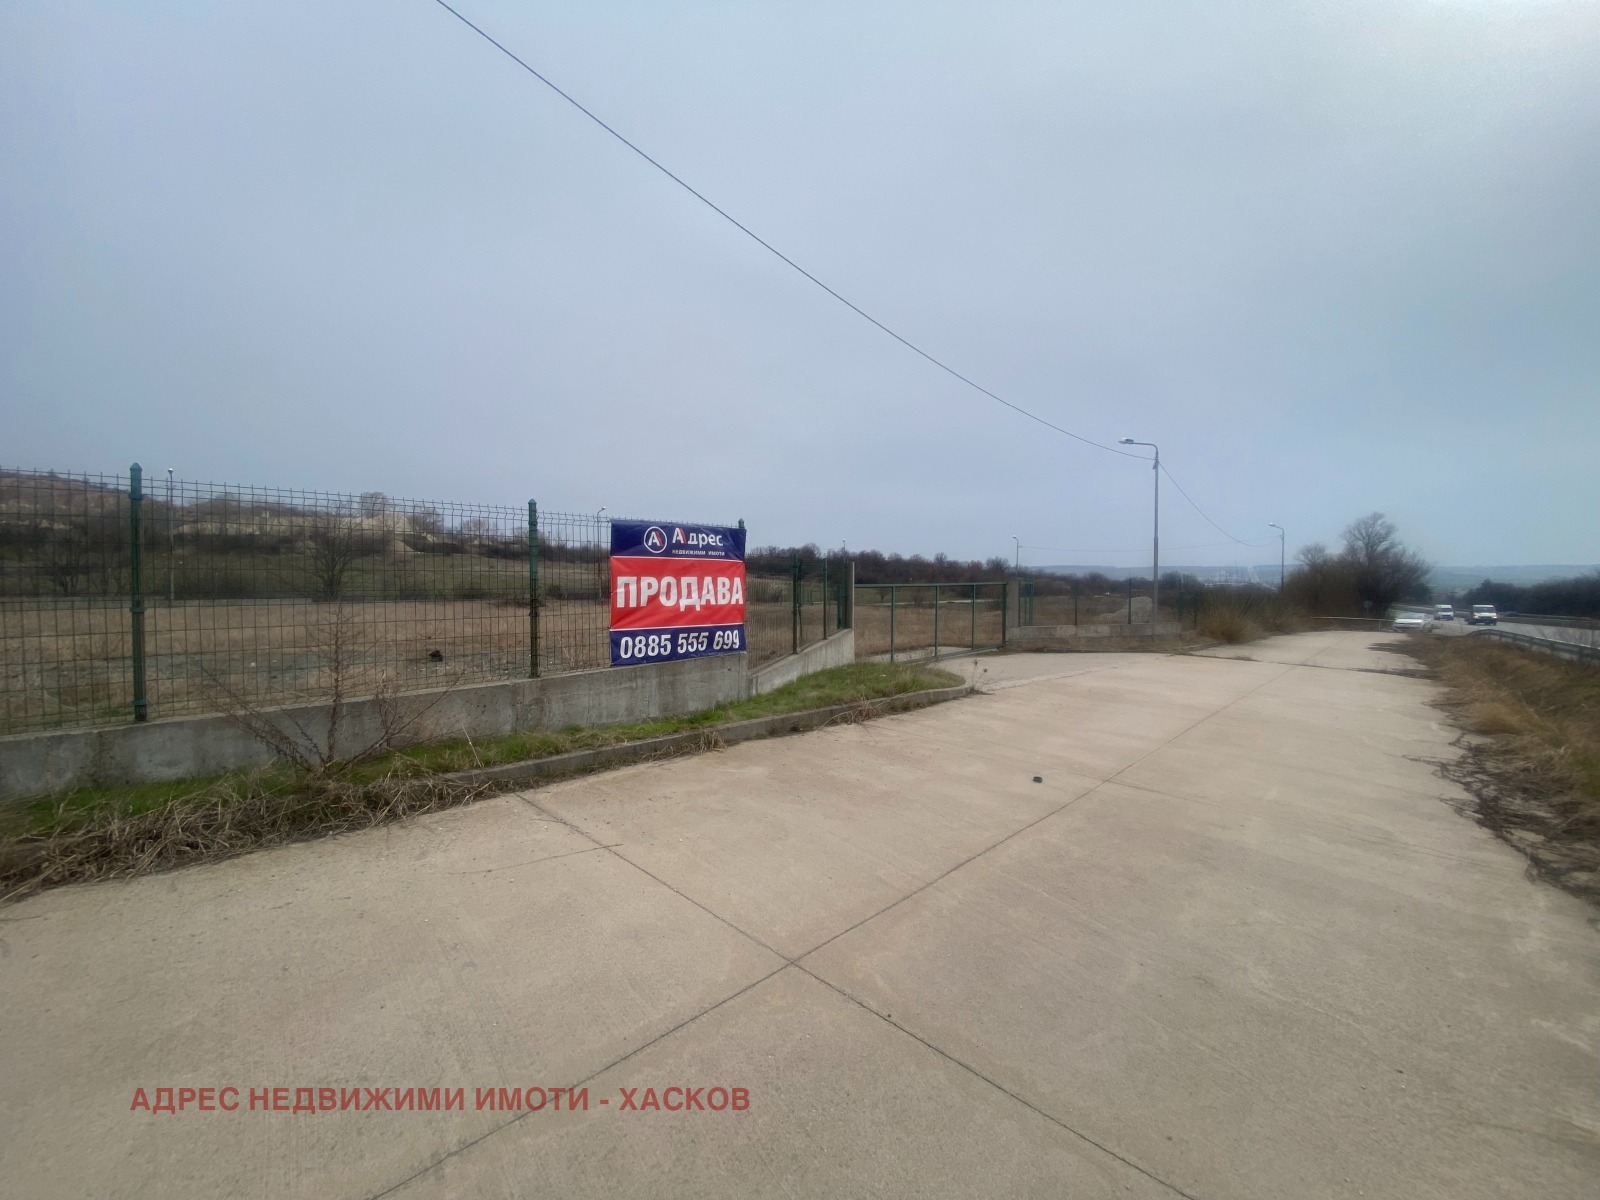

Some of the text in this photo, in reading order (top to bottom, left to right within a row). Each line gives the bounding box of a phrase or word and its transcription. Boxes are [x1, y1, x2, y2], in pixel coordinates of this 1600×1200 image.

[672, 527, 723, 549] Адрес
[616, 576, 744, 611] ПРОДАВА
[620, 629, 740, 659] 0885 555 699
